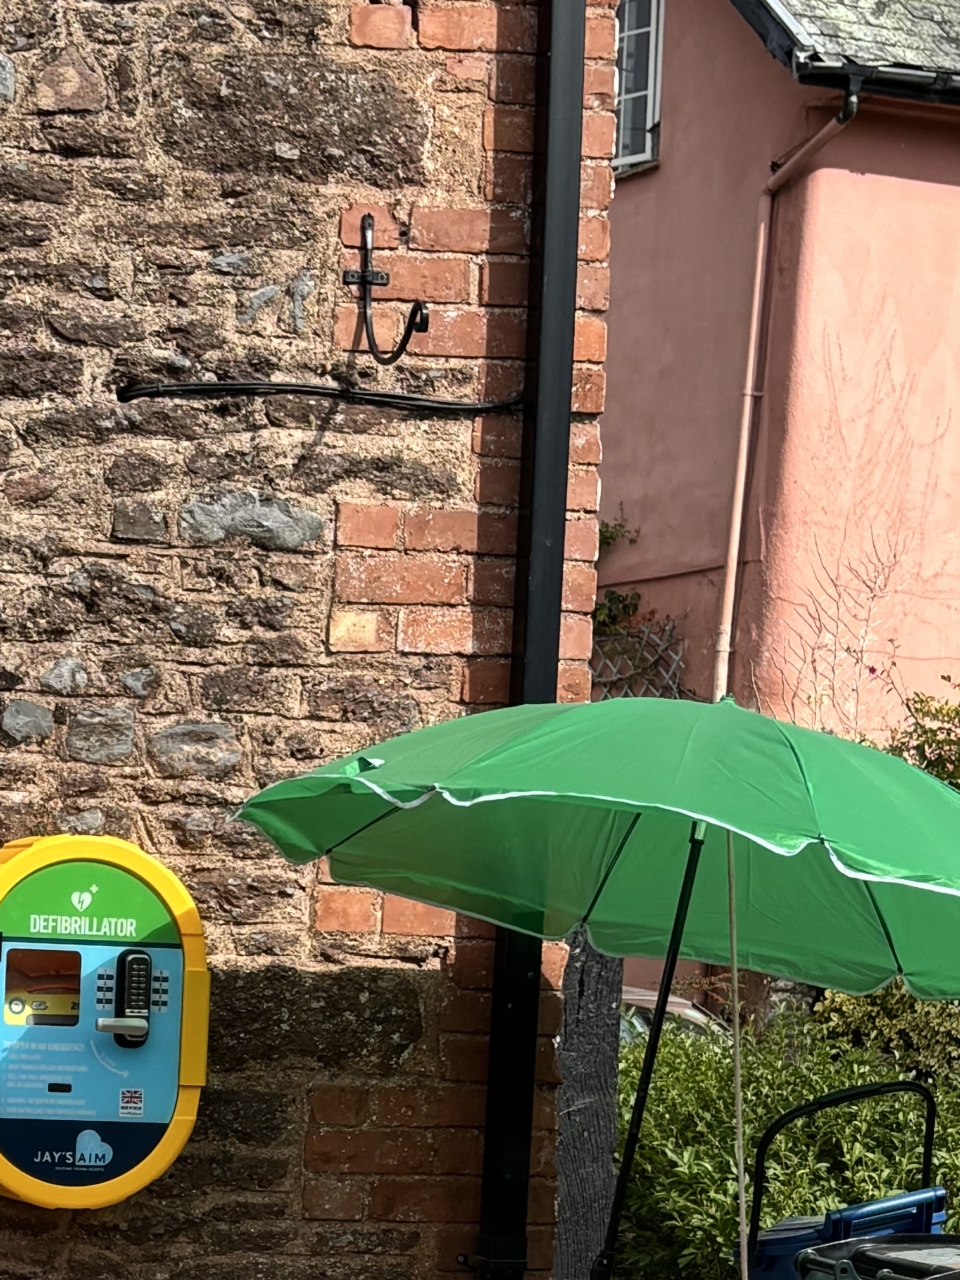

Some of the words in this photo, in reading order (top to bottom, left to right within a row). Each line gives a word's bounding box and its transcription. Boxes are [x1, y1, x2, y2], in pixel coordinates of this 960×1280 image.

[29, 914, 137, 937] DEFIBRILLATOR
[33, 1151, 73, 1164] JAY'S
[77, 1152, 106, 1164] AIM
